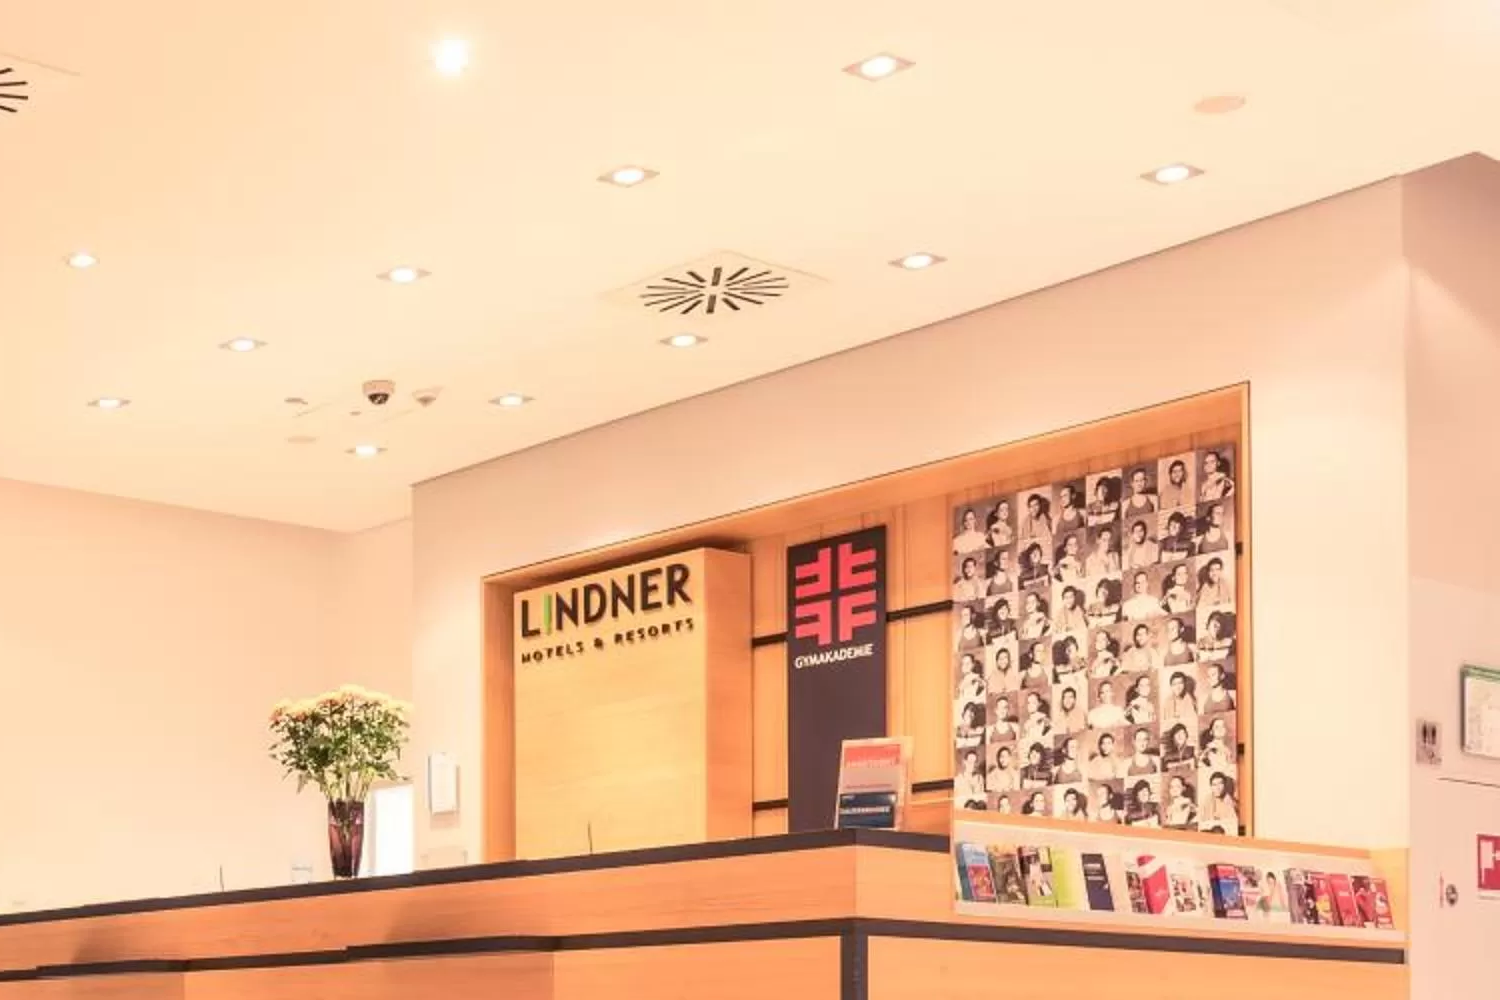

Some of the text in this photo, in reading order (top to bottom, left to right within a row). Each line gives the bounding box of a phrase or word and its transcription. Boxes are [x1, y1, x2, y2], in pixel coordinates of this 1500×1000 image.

[521, 563, 693, 639] LINDNER
[521, 617, 695, 664] HOTELS & RESORTS
[794, 643, 875, 669] GYMAKADEMIE
